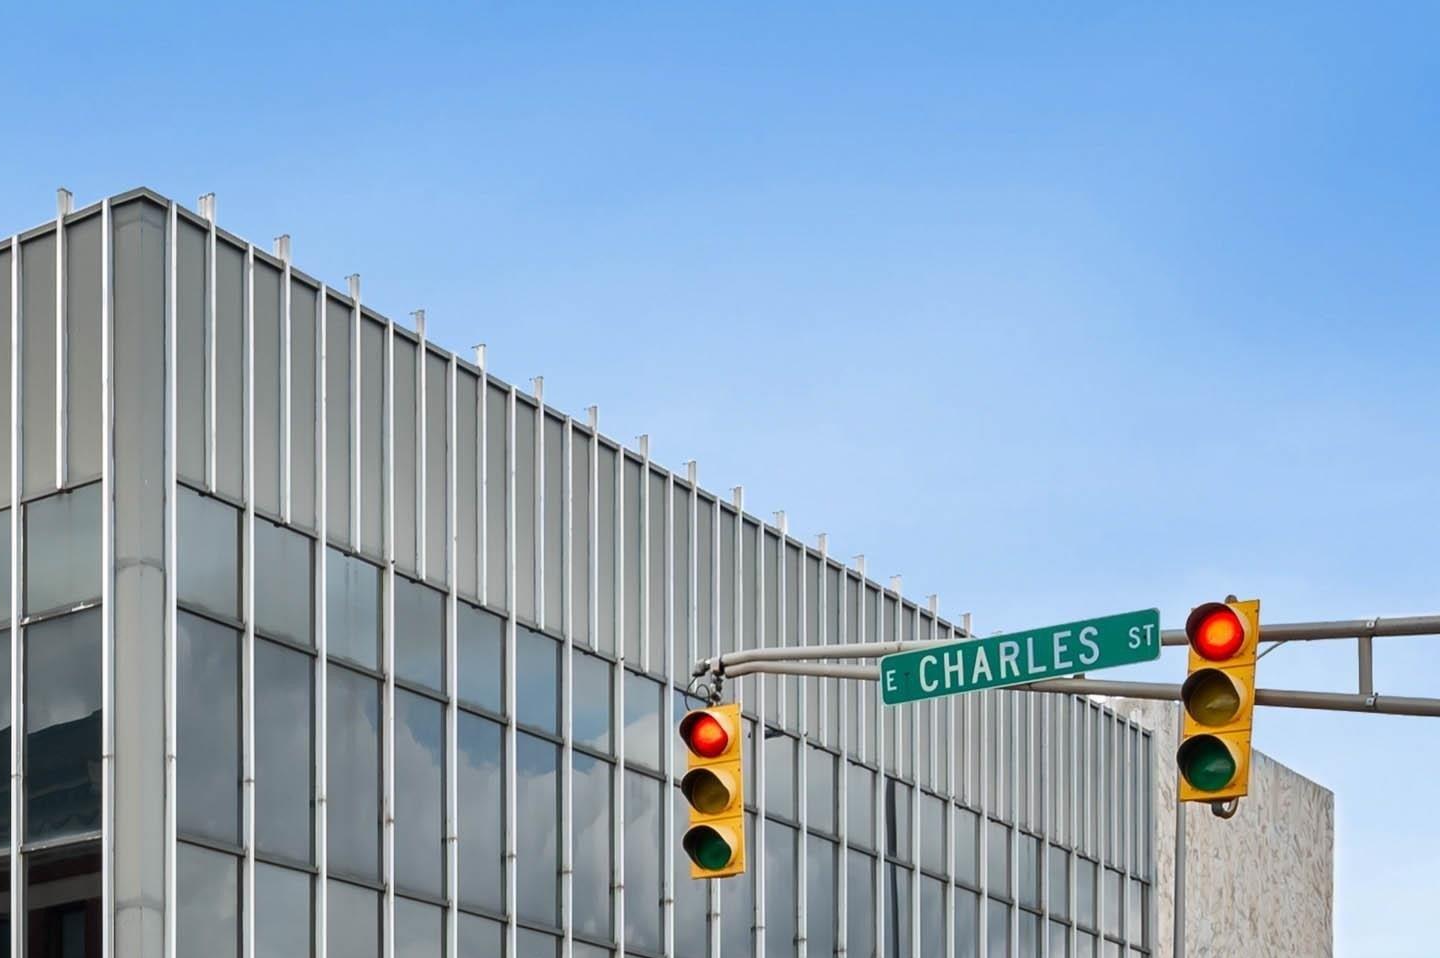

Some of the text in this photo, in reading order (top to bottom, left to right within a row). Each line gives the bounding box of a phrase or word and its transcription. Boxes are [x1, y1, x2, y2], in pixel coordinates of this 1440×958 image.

[886, 623, 1155, 693] E CHARLES ST
